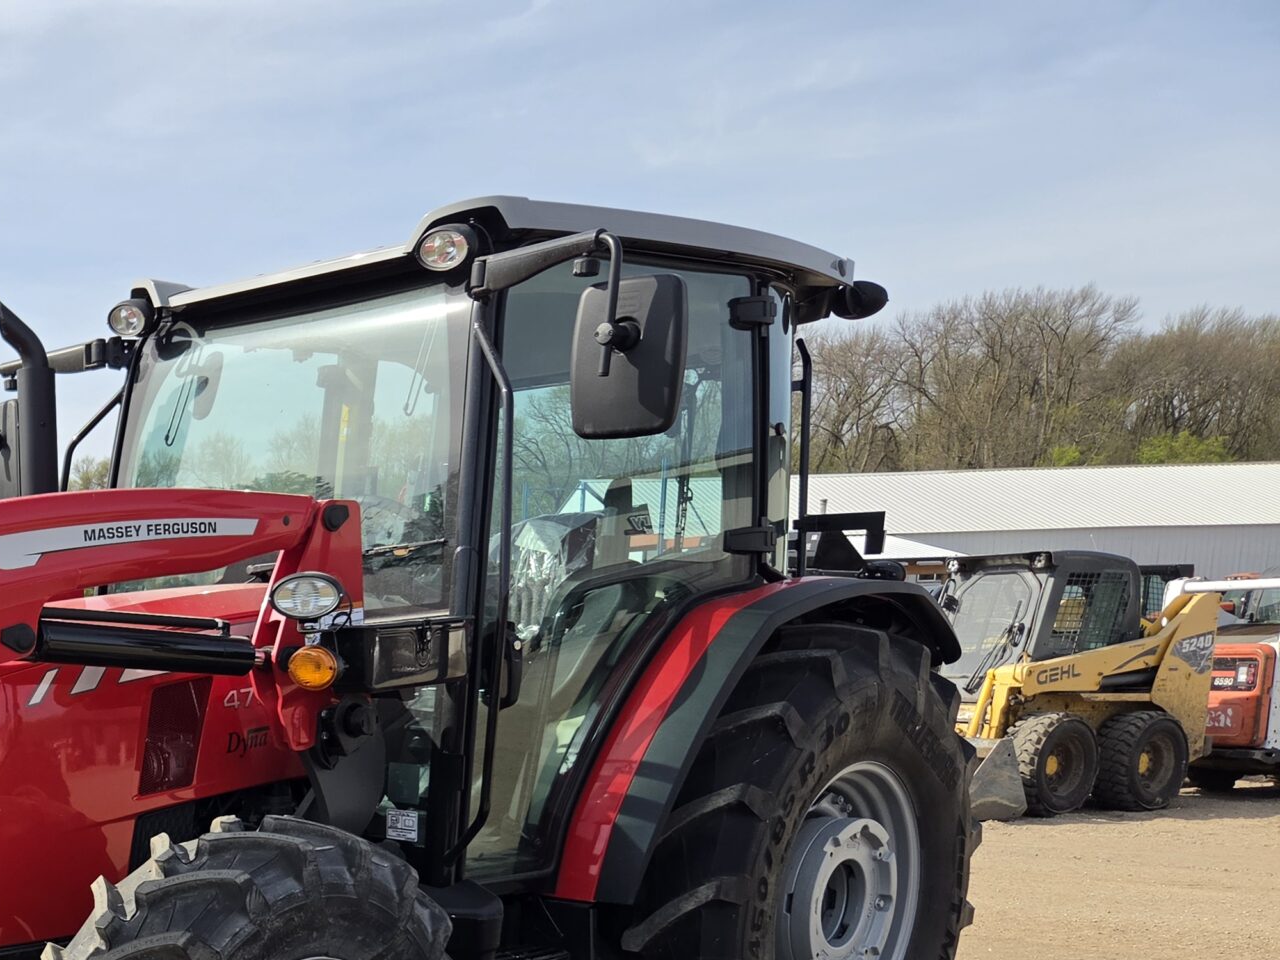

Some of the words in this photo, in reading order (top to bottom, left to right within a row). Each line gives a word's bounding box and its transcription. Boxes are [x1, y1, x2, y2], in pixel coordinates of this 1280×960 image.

[83, 524, 142, 542] MASSEY
[146, 521, 218, 537] FERGUSON
[1181, 634, 1213, 653] 5240
[1036, 663, 1082, 686] GEHL
[223, 686, 255, 709] 47
